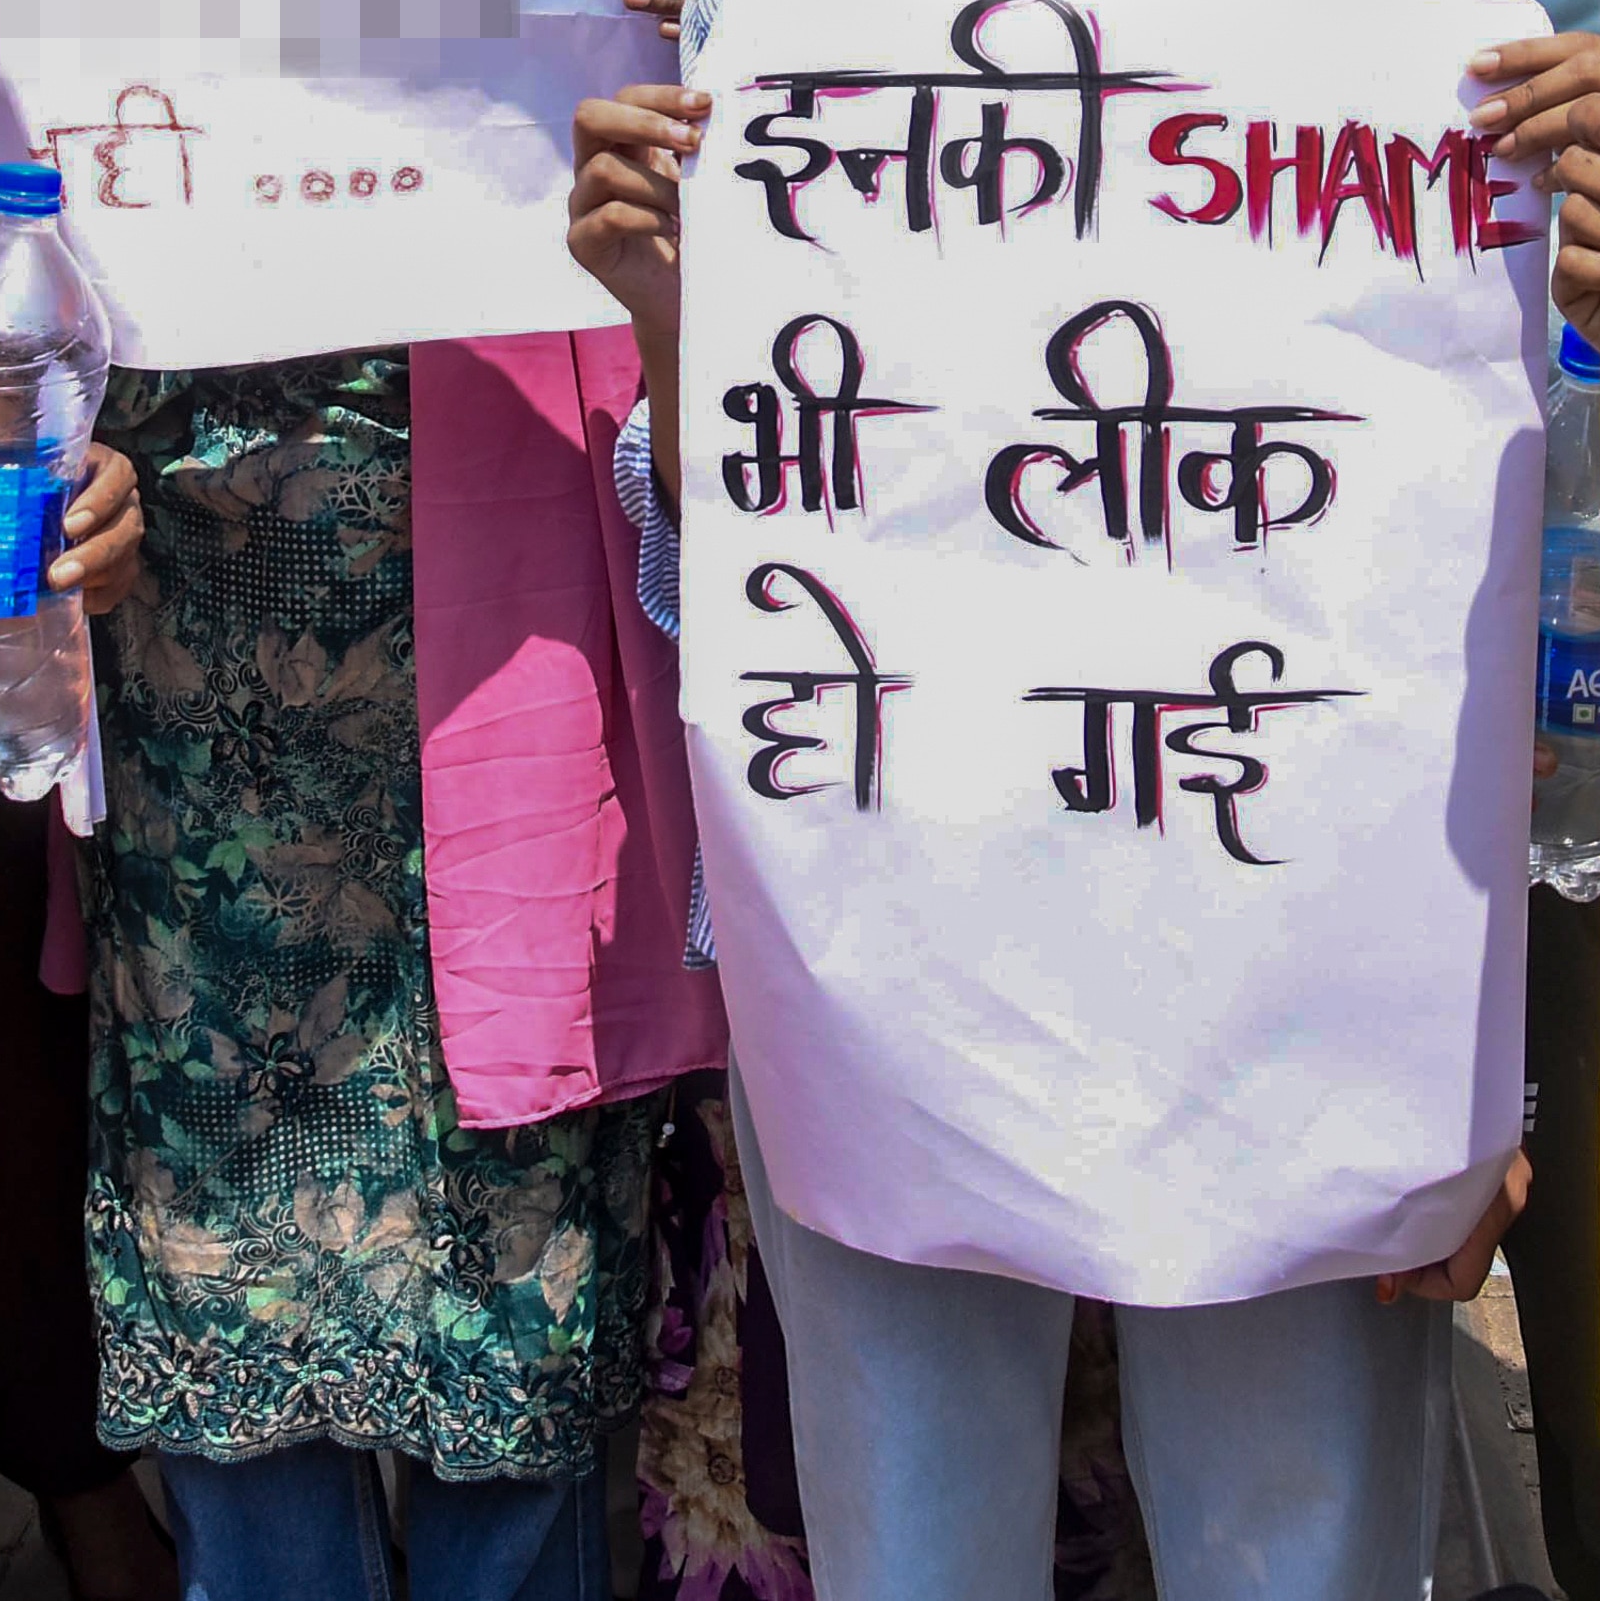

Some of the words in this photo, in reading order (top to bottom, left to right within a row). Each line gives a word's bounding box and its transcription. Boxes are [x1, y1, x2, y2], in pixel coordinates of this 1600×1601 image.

[1146, 110, 1550, 280] SHAME
[720, 311, 942, 535] भी
[983, 298, 1369, 574] लीक
[738, 561, 920, 813] हो
[1020, 639, 1374, 867] गई
